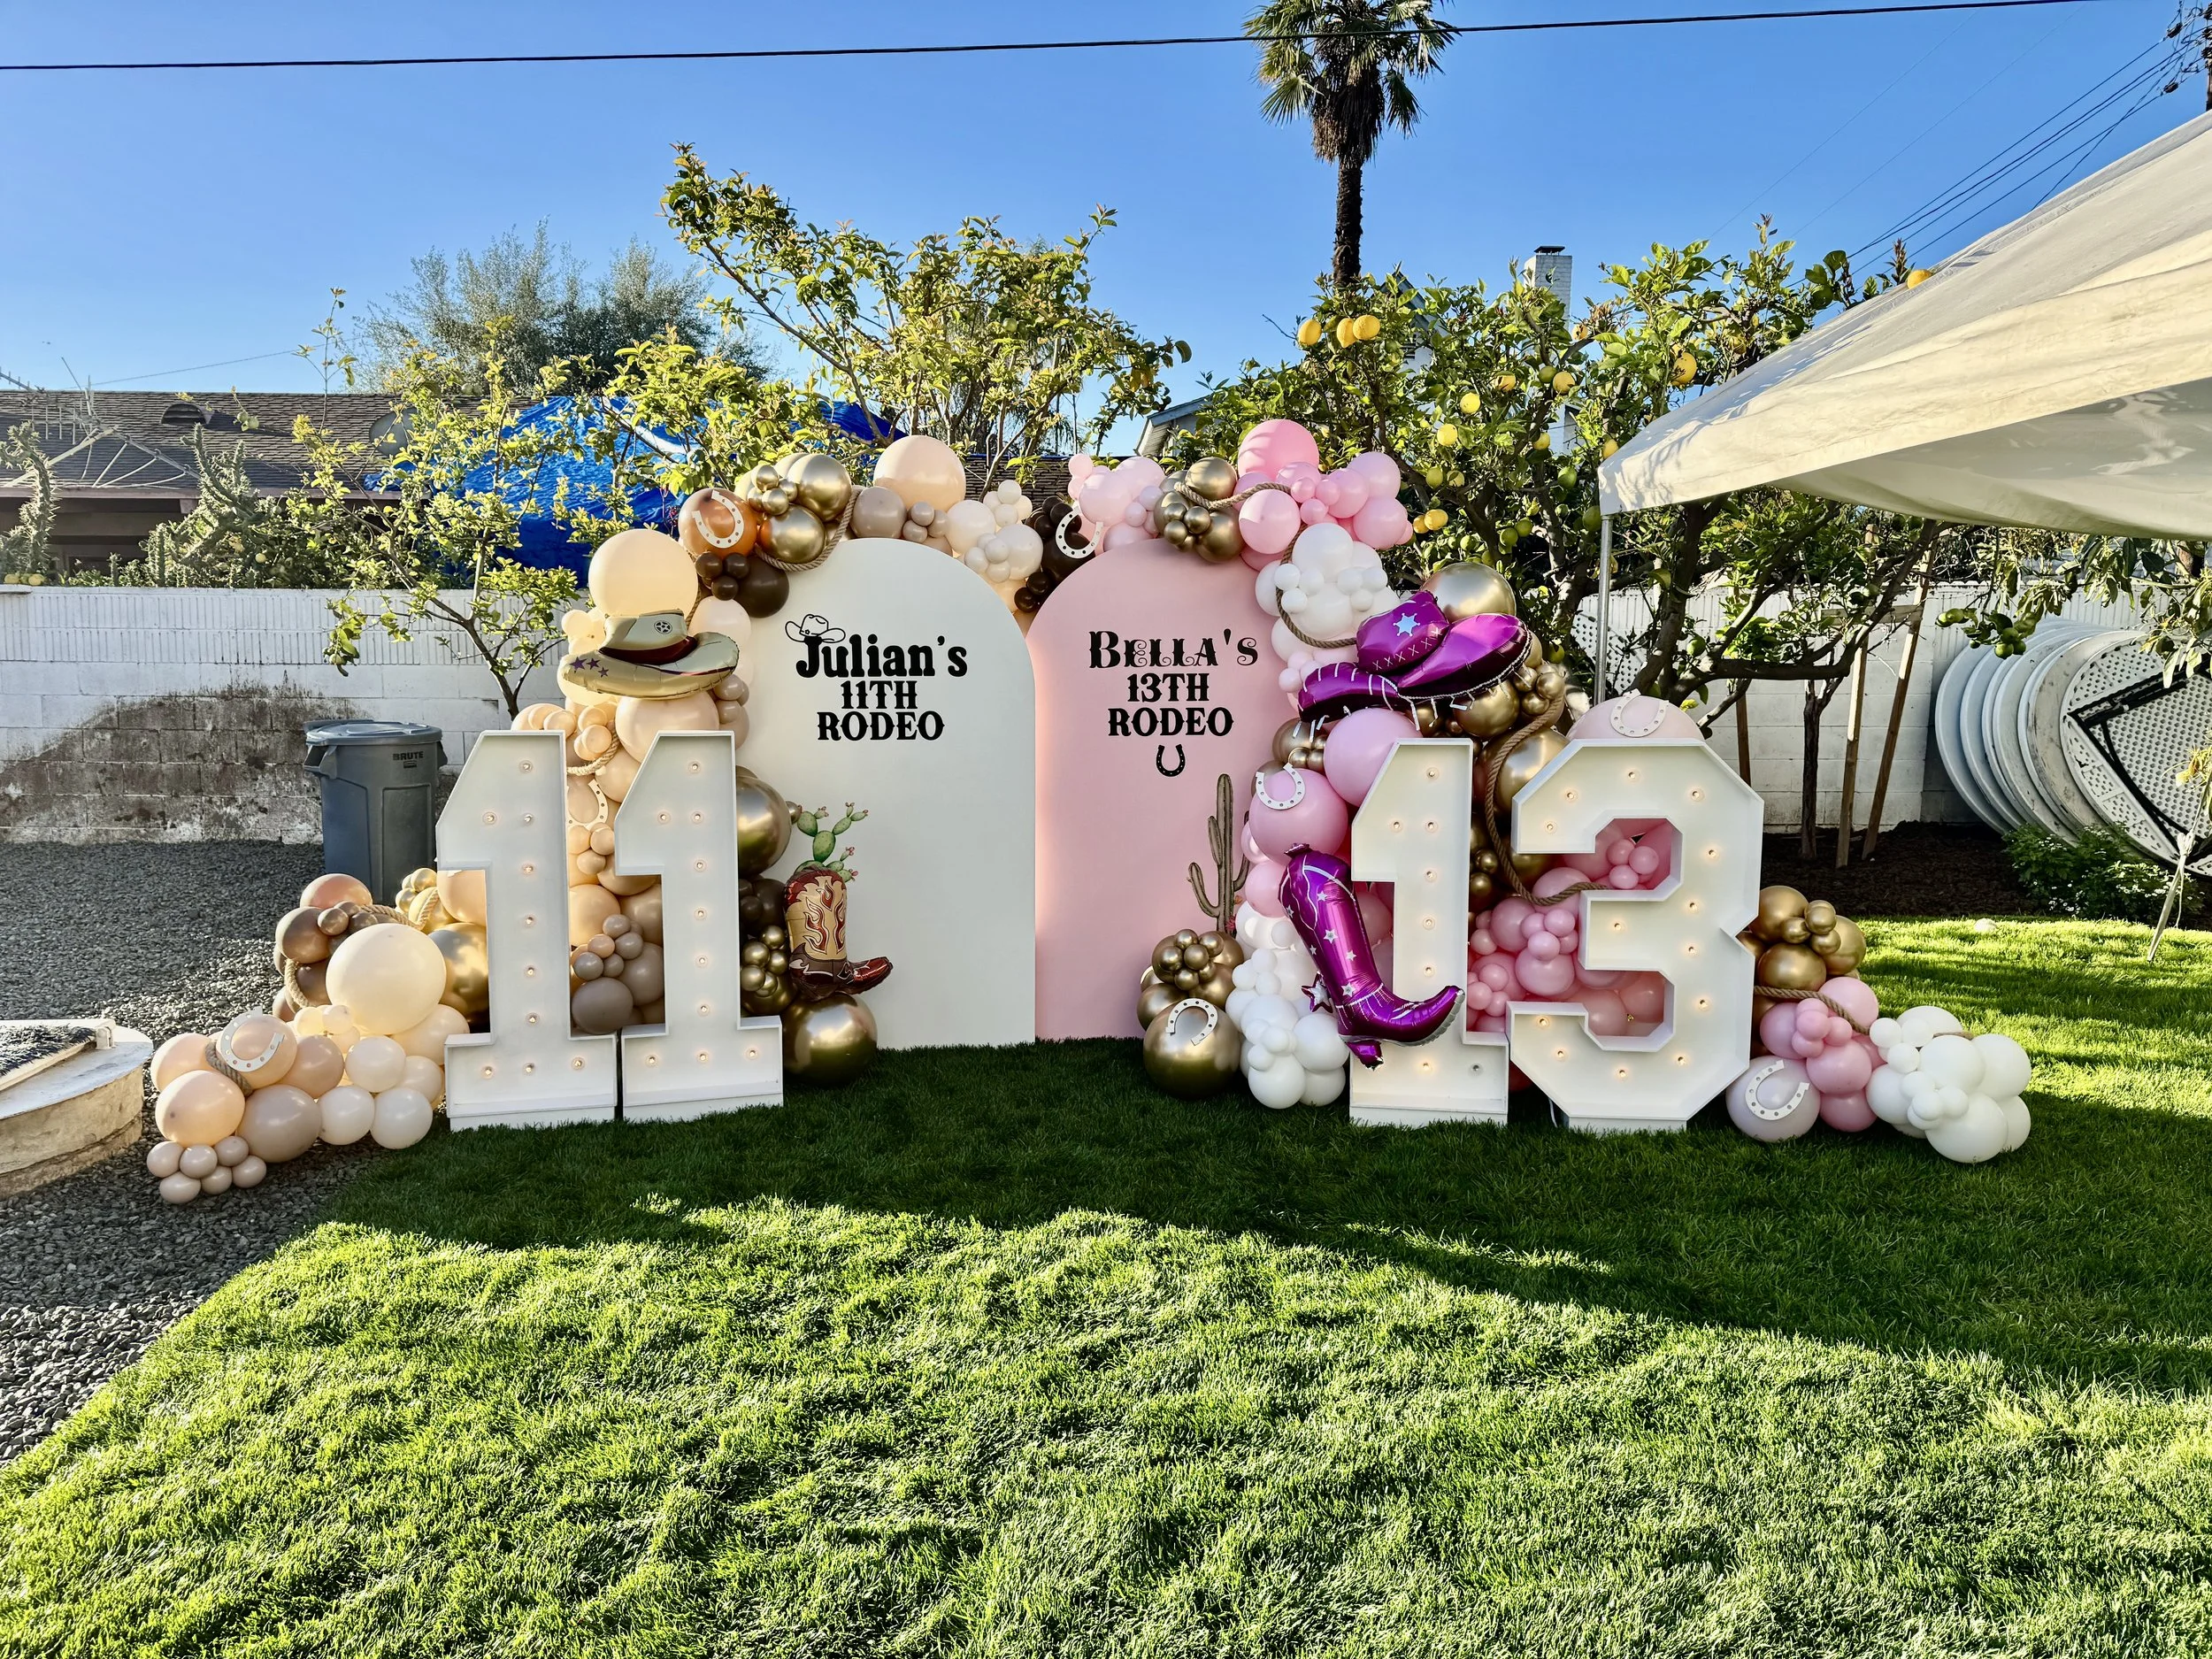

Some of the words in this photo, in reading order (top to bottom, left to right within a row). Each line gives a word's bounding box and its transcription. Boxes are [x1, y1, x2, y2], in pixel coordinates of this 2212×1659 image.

[795, 634, 968, 679] Julian's
[840, 680, 918, 710] 11TH
[1126, 672, 1210, 703] 13TH
[817, 710, 945, 741] RODEO
[1107, 707, 1234, 737] RODEO
[393, 751, 424, 761] BRUTE
